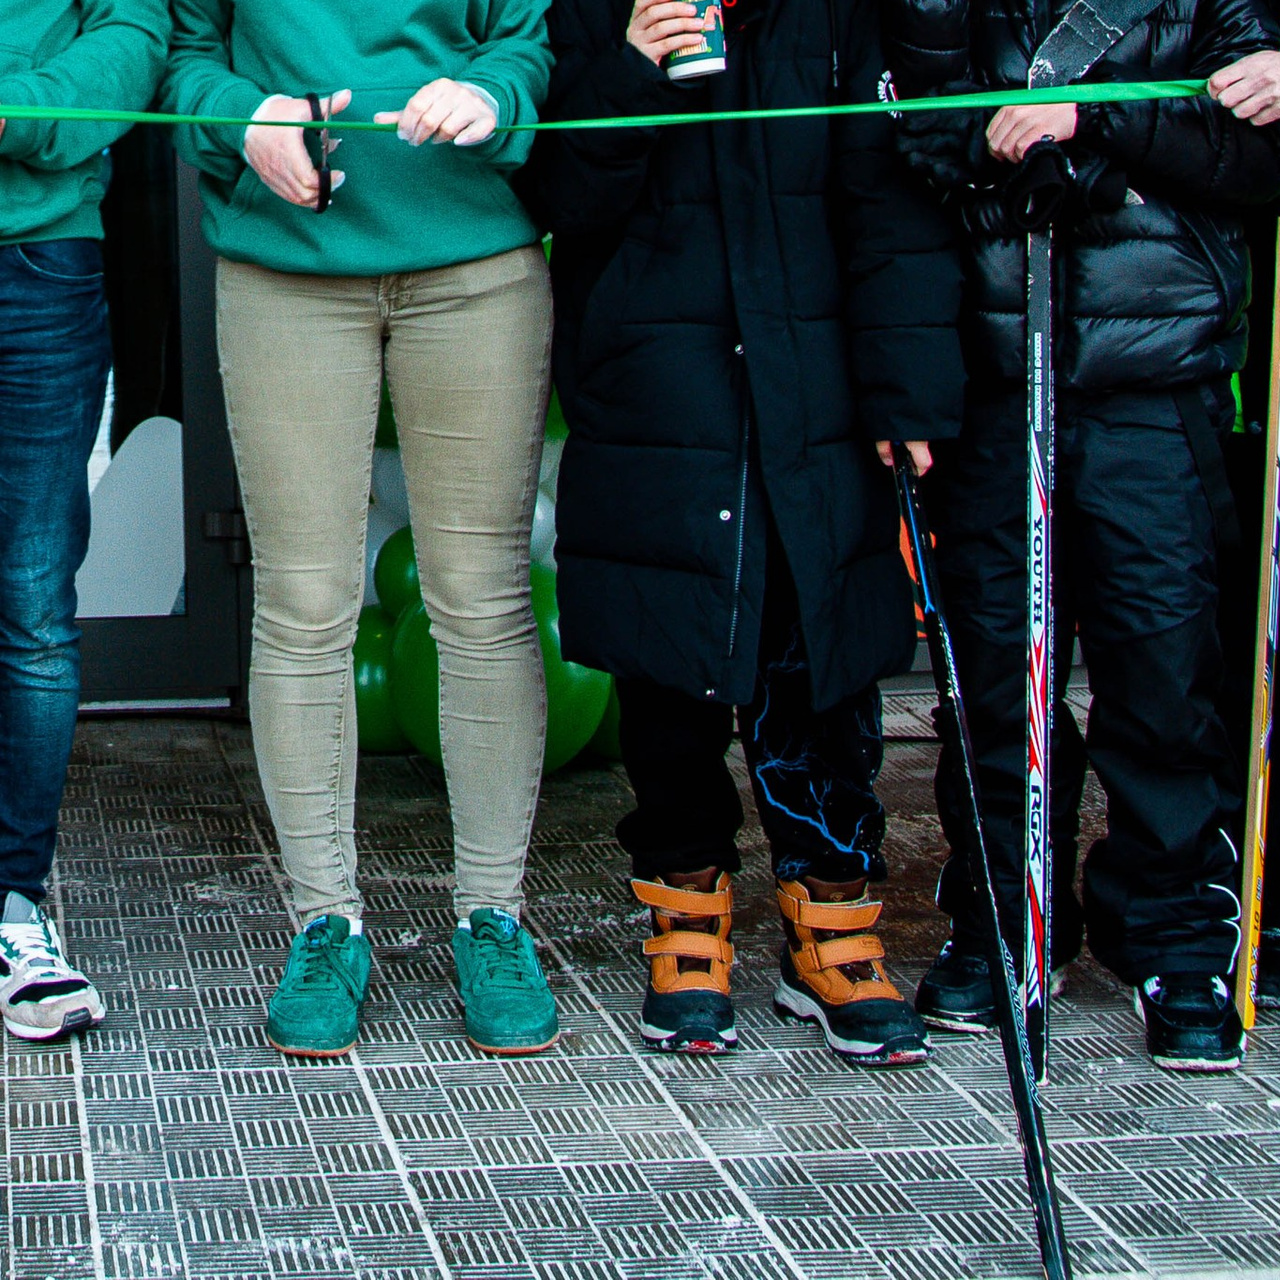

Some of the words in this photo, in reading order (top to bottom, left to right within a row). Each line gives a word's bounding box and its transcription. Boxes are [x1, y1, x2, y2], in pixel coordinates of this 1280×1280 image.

[1033, 514, 1043, 625] YOUTH
[1030, 784, 1043, 867] RGX
[1249, 943, 1259, 1004] MAX
